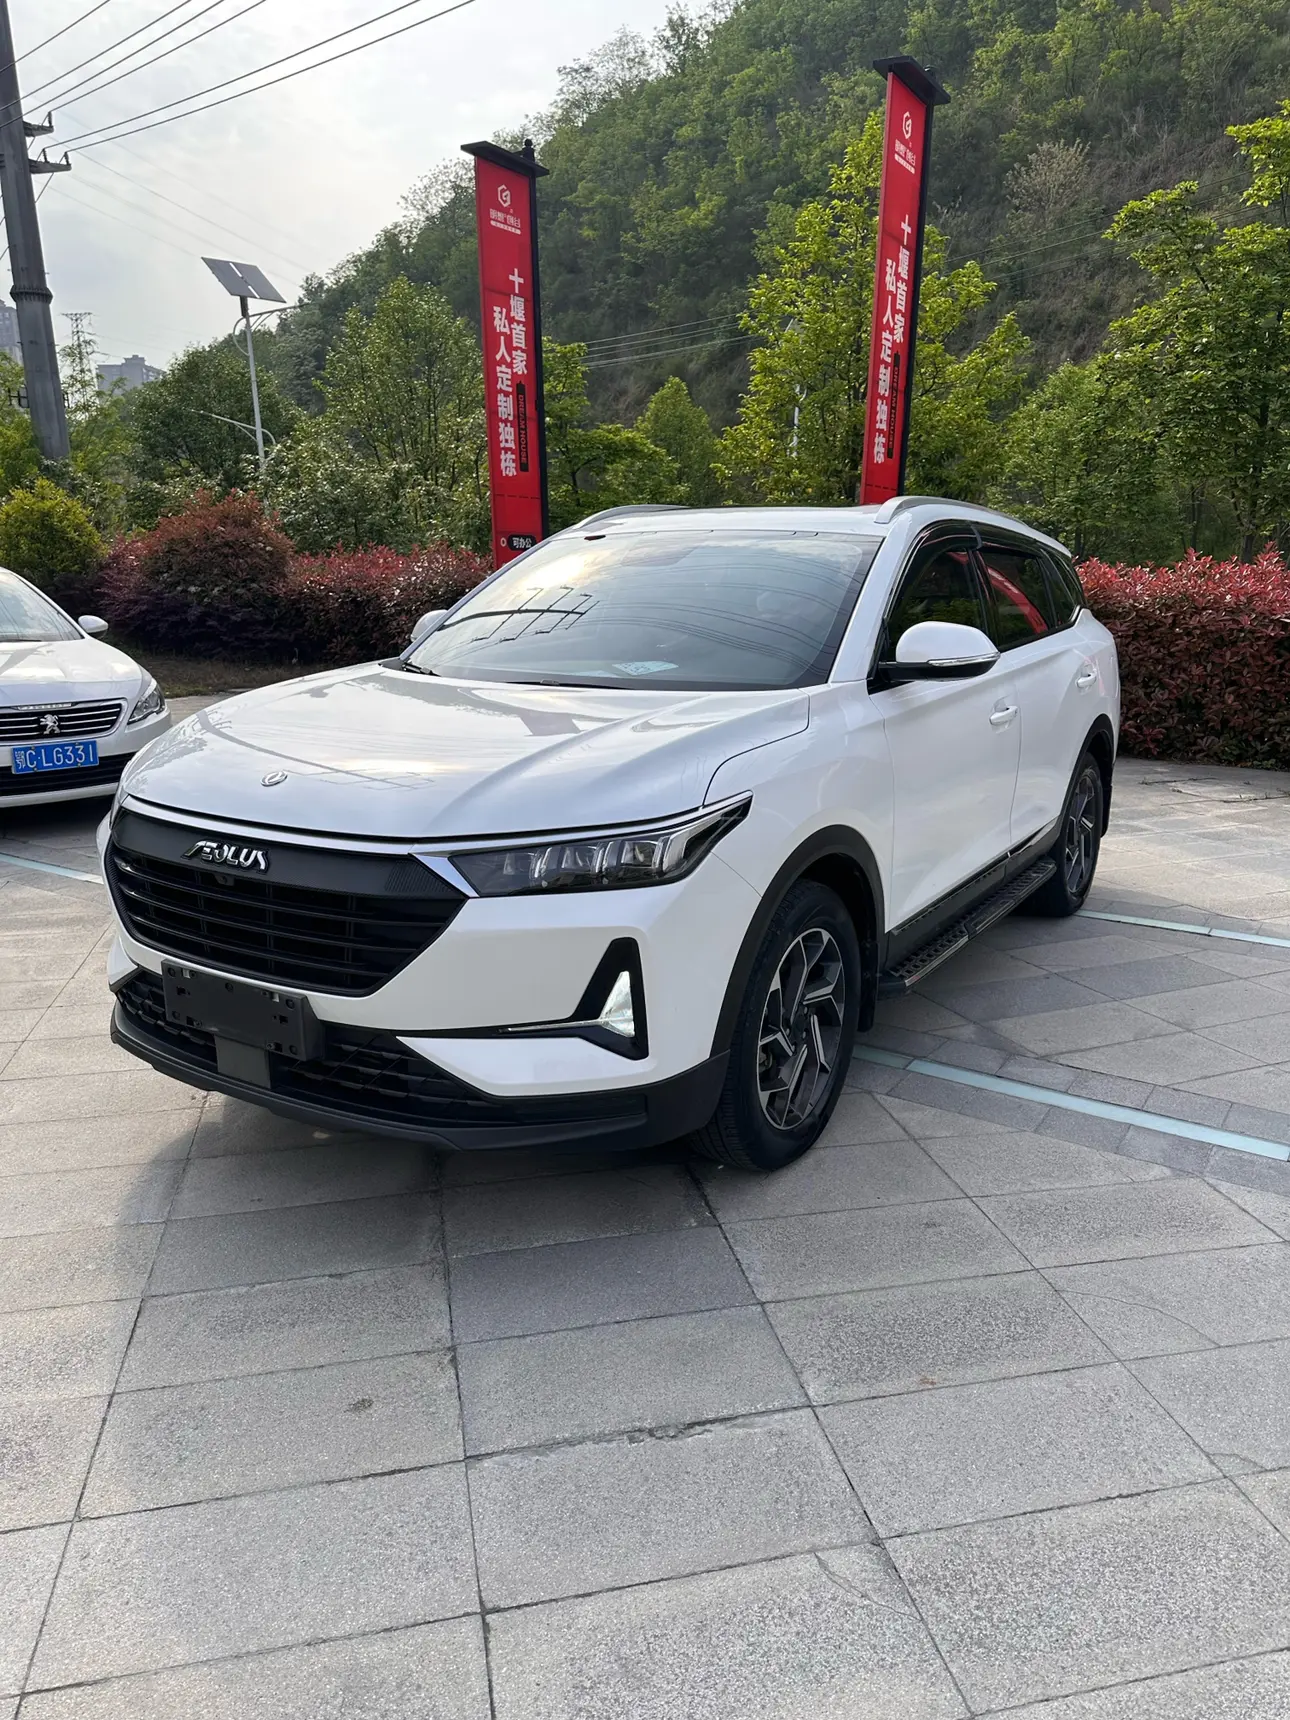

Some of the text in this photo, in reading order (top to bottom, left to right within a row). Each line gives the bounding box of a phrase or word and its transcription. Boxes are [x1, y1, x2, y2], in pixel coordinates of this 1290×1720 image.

[508, 268, 527, 375] 十堰首家
[893, 214, 911, 343] 十堰首家
[493, 305, 517, 477] 私人定制独栋
[874, 258, 896, 464] 私人定制独栋
[517, 394, 528, 464] DREAM HOUSE
[512, 537, 532, 548] 可办公
[182, 839, 269, 872] AEOLUS
